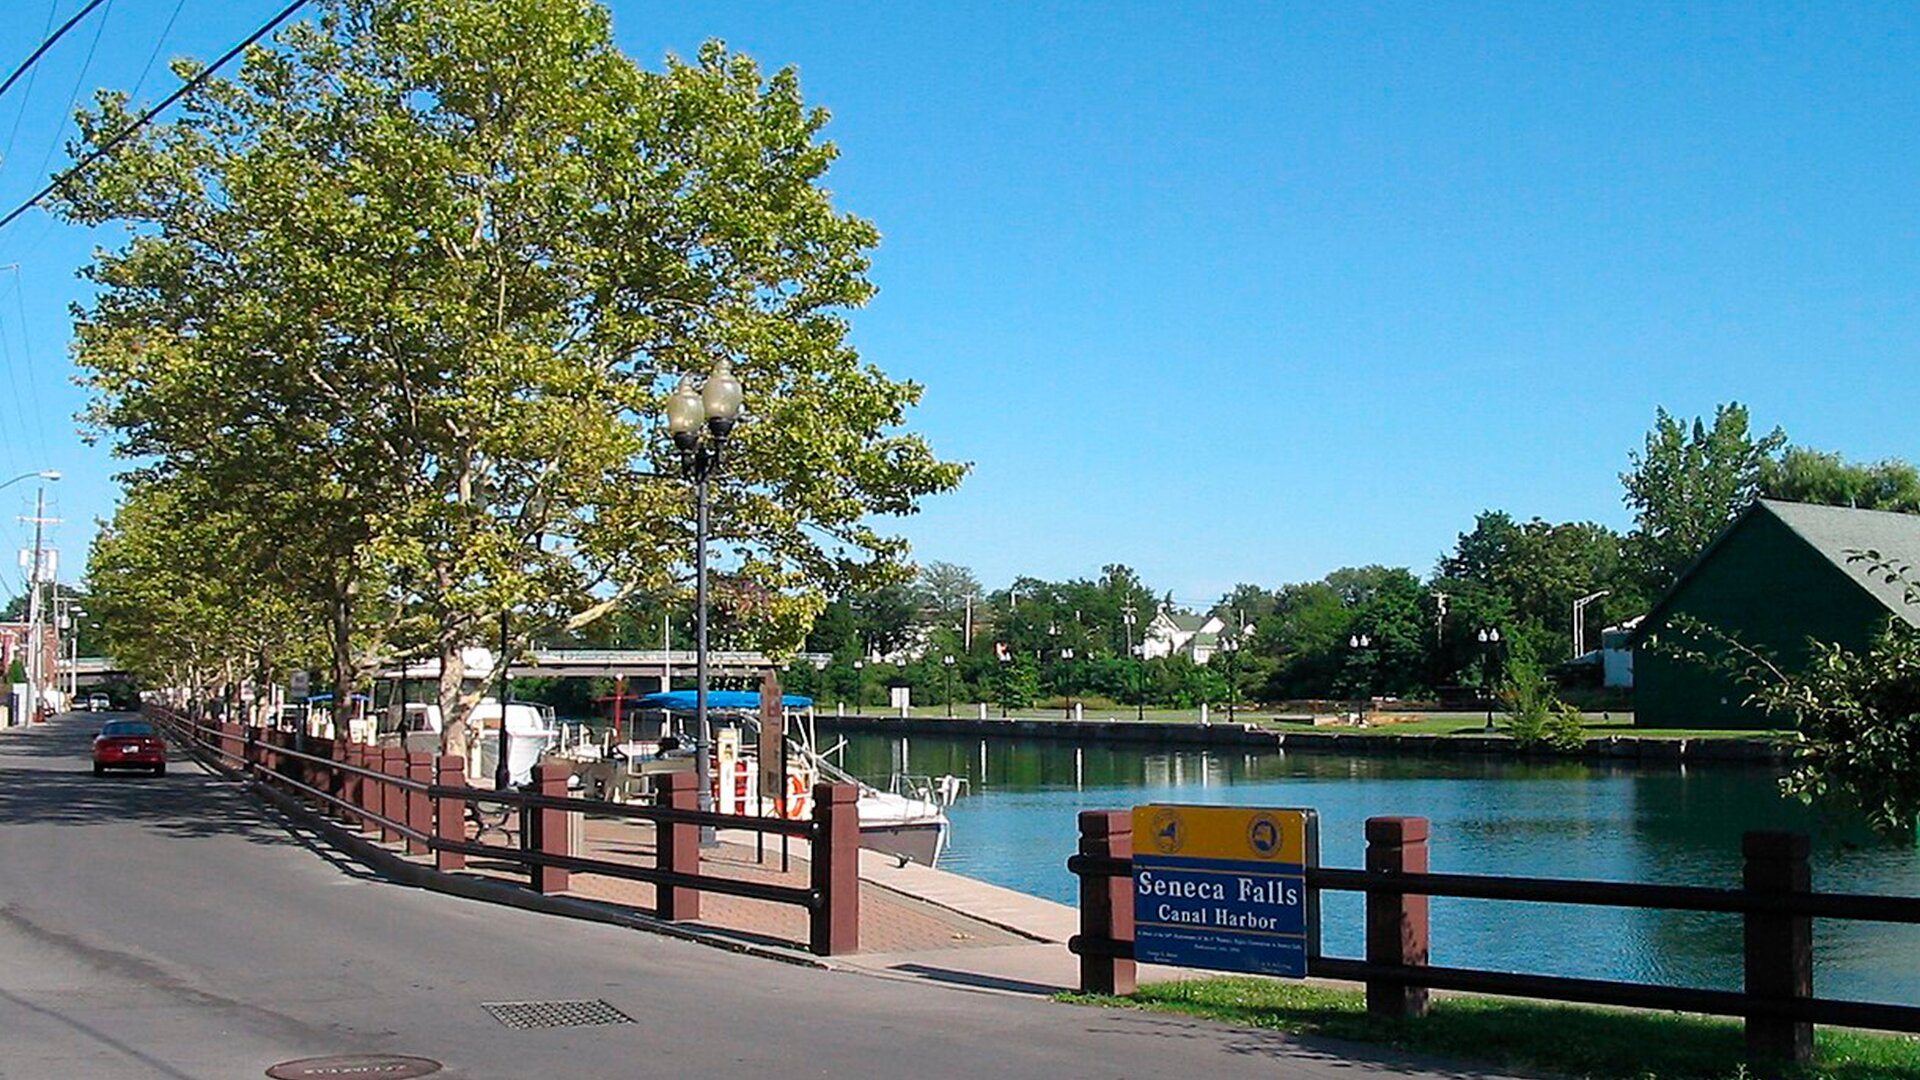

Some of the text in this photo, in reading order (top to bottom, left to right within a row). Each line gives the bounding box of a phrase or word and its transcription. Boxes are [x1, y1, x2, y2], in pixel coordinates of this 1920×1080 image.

[1139, 871, 1298, 905] Seneca Falls
[1158, 904, 1278, 930] Canal Harbor
